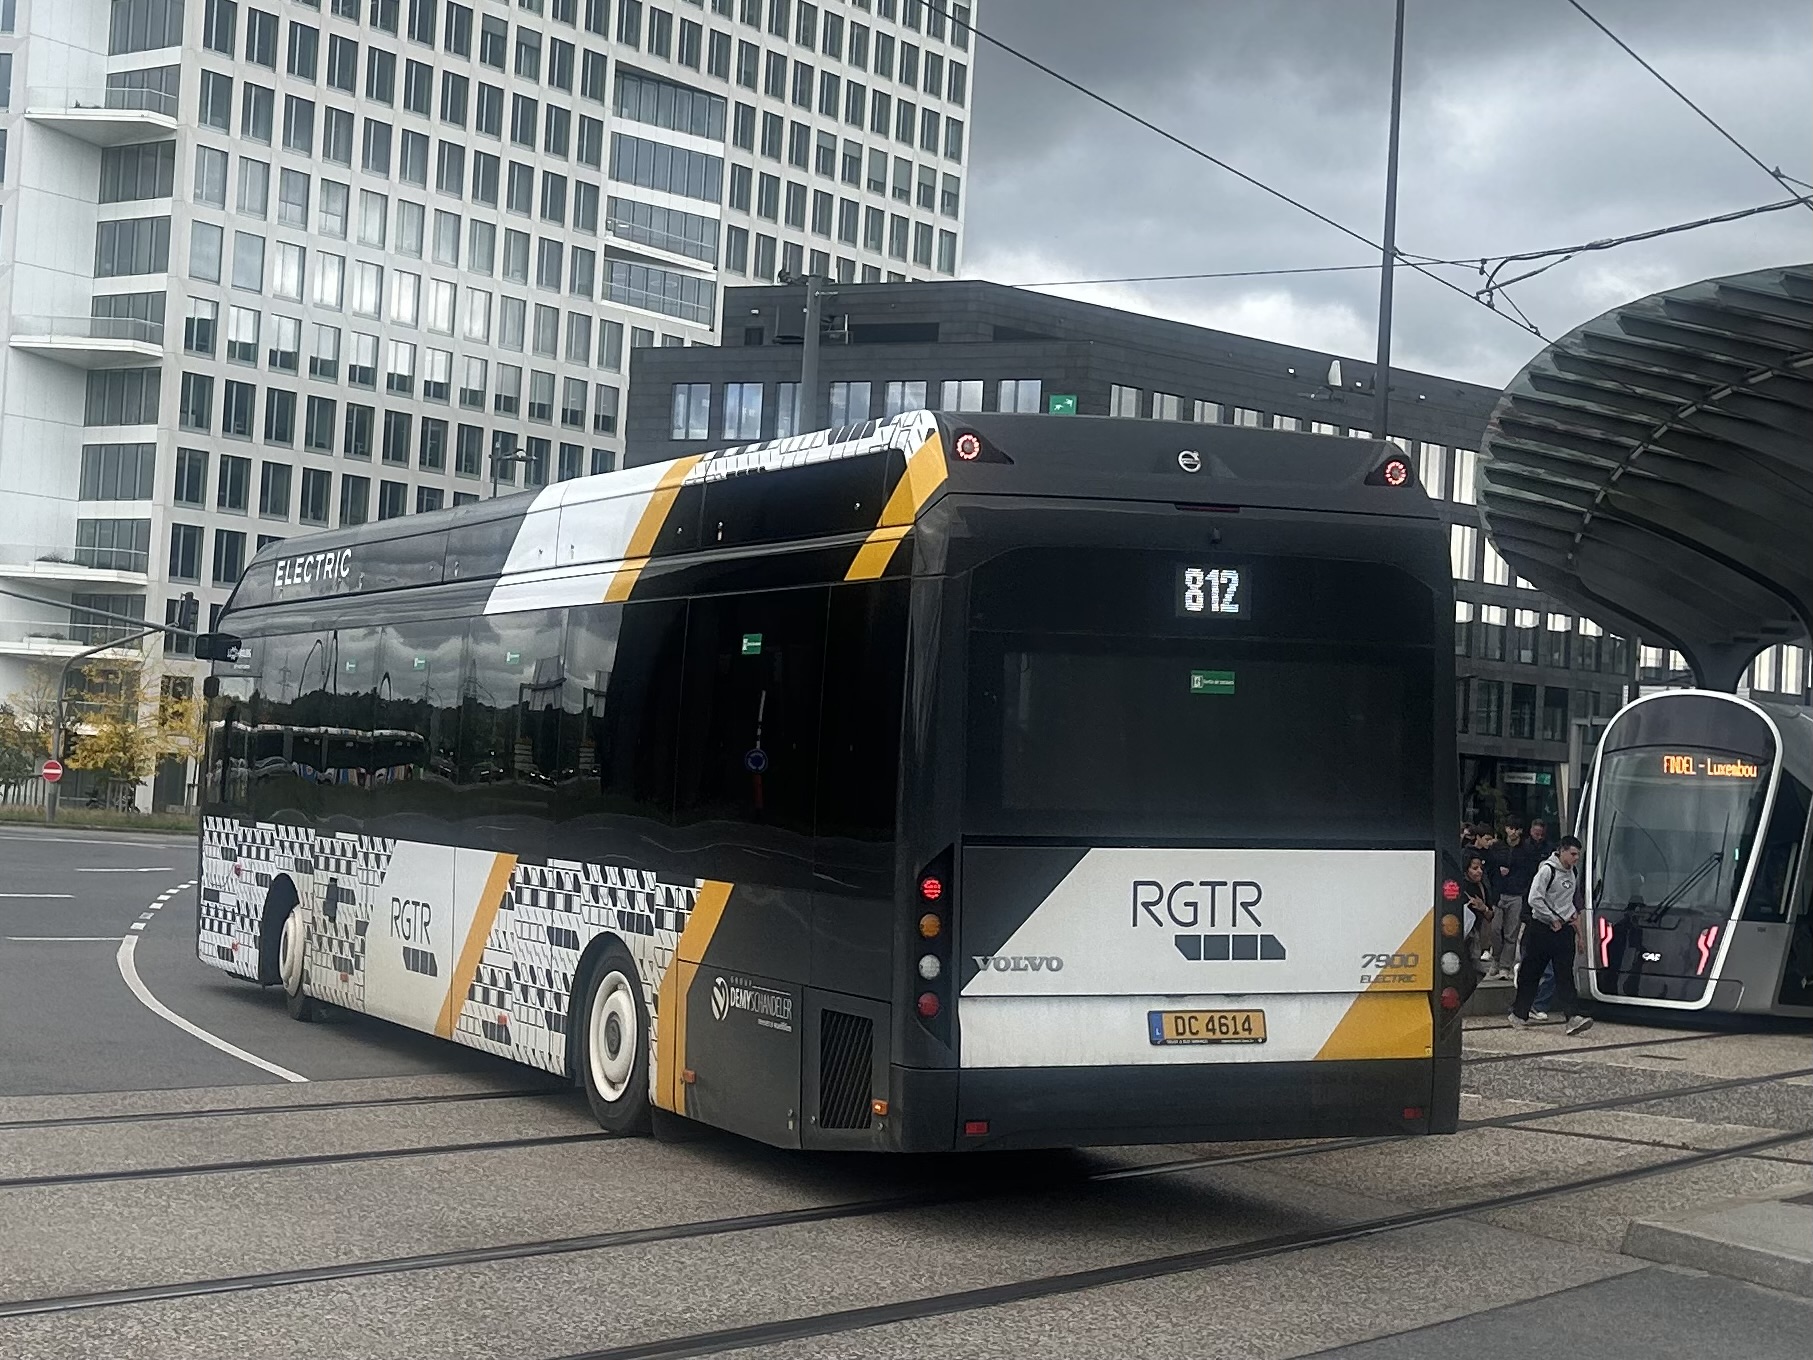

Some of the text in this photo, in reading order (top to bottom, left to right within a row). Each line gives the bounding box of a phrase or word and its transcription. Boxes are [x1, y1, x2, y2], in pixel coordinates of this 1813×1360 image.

[274, 548, 352, 587] ELECTRIC
[1184, 567, 1240, 613] 812
[1663, 755, 1697, 775] FINDEL
[1132, 880, 1263, 928] RGTR
[390, 896, 432, 945] RGTR
[972, 955, 1064, 972] VOLVO
[1361, 953, 1420, 969] 7900
[1174, 1014, 1253, 1037] DC 4614
